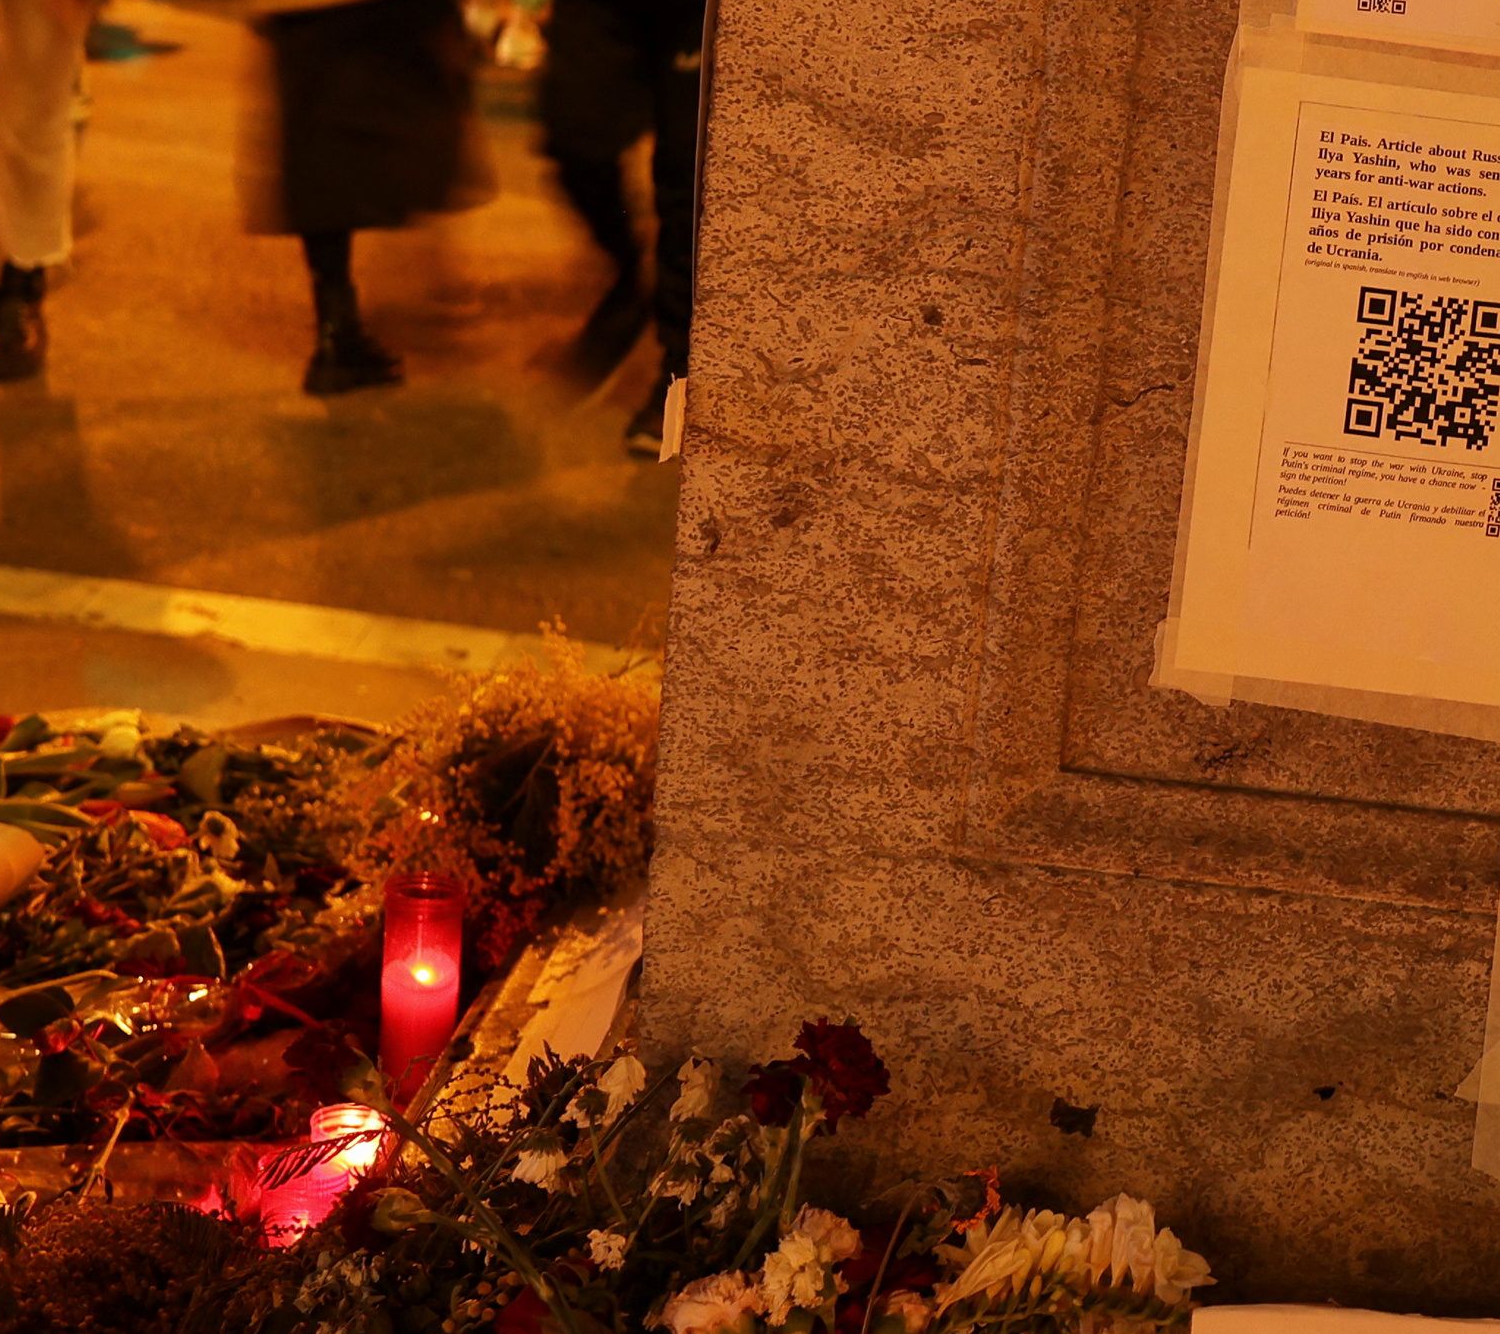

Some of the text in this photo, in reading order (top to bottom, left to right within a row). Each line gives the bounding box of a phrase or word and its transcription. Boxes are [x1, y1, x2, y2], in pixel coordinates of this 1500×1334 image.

[1319, 130, 1335, 143] El
[1375, 137, 1422, 154] Article
[1427, 143, 1466, 160] about
[1317, 147, 1343, 164] Ilya
[1409, 159, 1437, 173] who
[1445, 165, 1471, 177] was
[1314, 167, 1486, 197] years for anti-war actions.
[1312, 188, 1328, 202] El
[1331, 191, 1363, 206] País.
[1366, 195, 1383, 208] El
[1385, 199, 1437, 215] artículo
[1440, 205, 1478, 220] sobre
[1480, 209, 1493, 222] el
[1310, 206, 1341, 223] Iliya
[1345, 210, 1390, 227] Yashin
[1394, 219, 1420, 233] que
[1423, 219, 1441, 234] ha
[1444, 223, 1473, 238] sido
[1306, 240, 1382, 261] de Ucrania.
[1307, 223, 1339, 238] años
[1344, 227, 1362, 241] de
[1366, 231, 1413, 248] prisión
[1418, 239, 1444, 253] por
